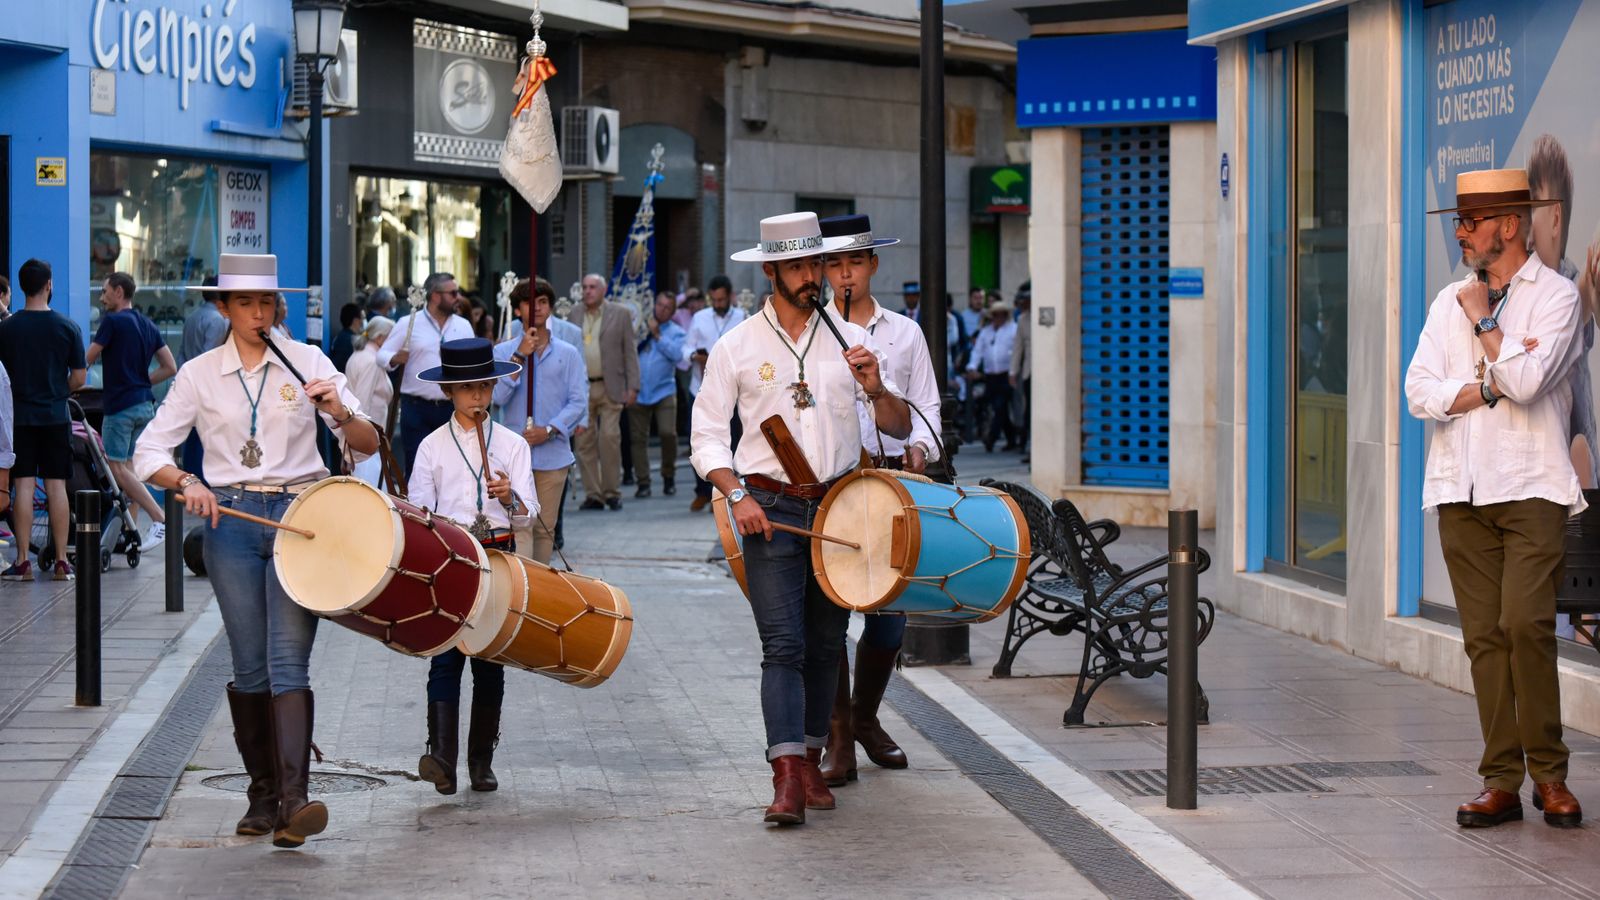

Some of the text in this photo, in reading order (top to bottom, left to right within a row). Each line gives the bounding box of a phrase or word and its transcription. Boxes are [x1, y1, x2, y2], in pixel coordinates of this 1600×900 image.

[1437, 14, 1496, 54] A TU LADO
[94, 0, 256, 111] Cienpiés
[1437, 41, 1512, 90] CUANDO MÁS
[1437, 84, 1514, 126] LO NECESITAS
[1447, 140, 1490, 166] Preventiva
[226, 171, 262, 191] GEOX
[230, 210, 256, 230] CAMPER
[226, 232, 241, 248] FOR
[788, 239, 798, 251] DE
[798, 237, 807, 250] LA
